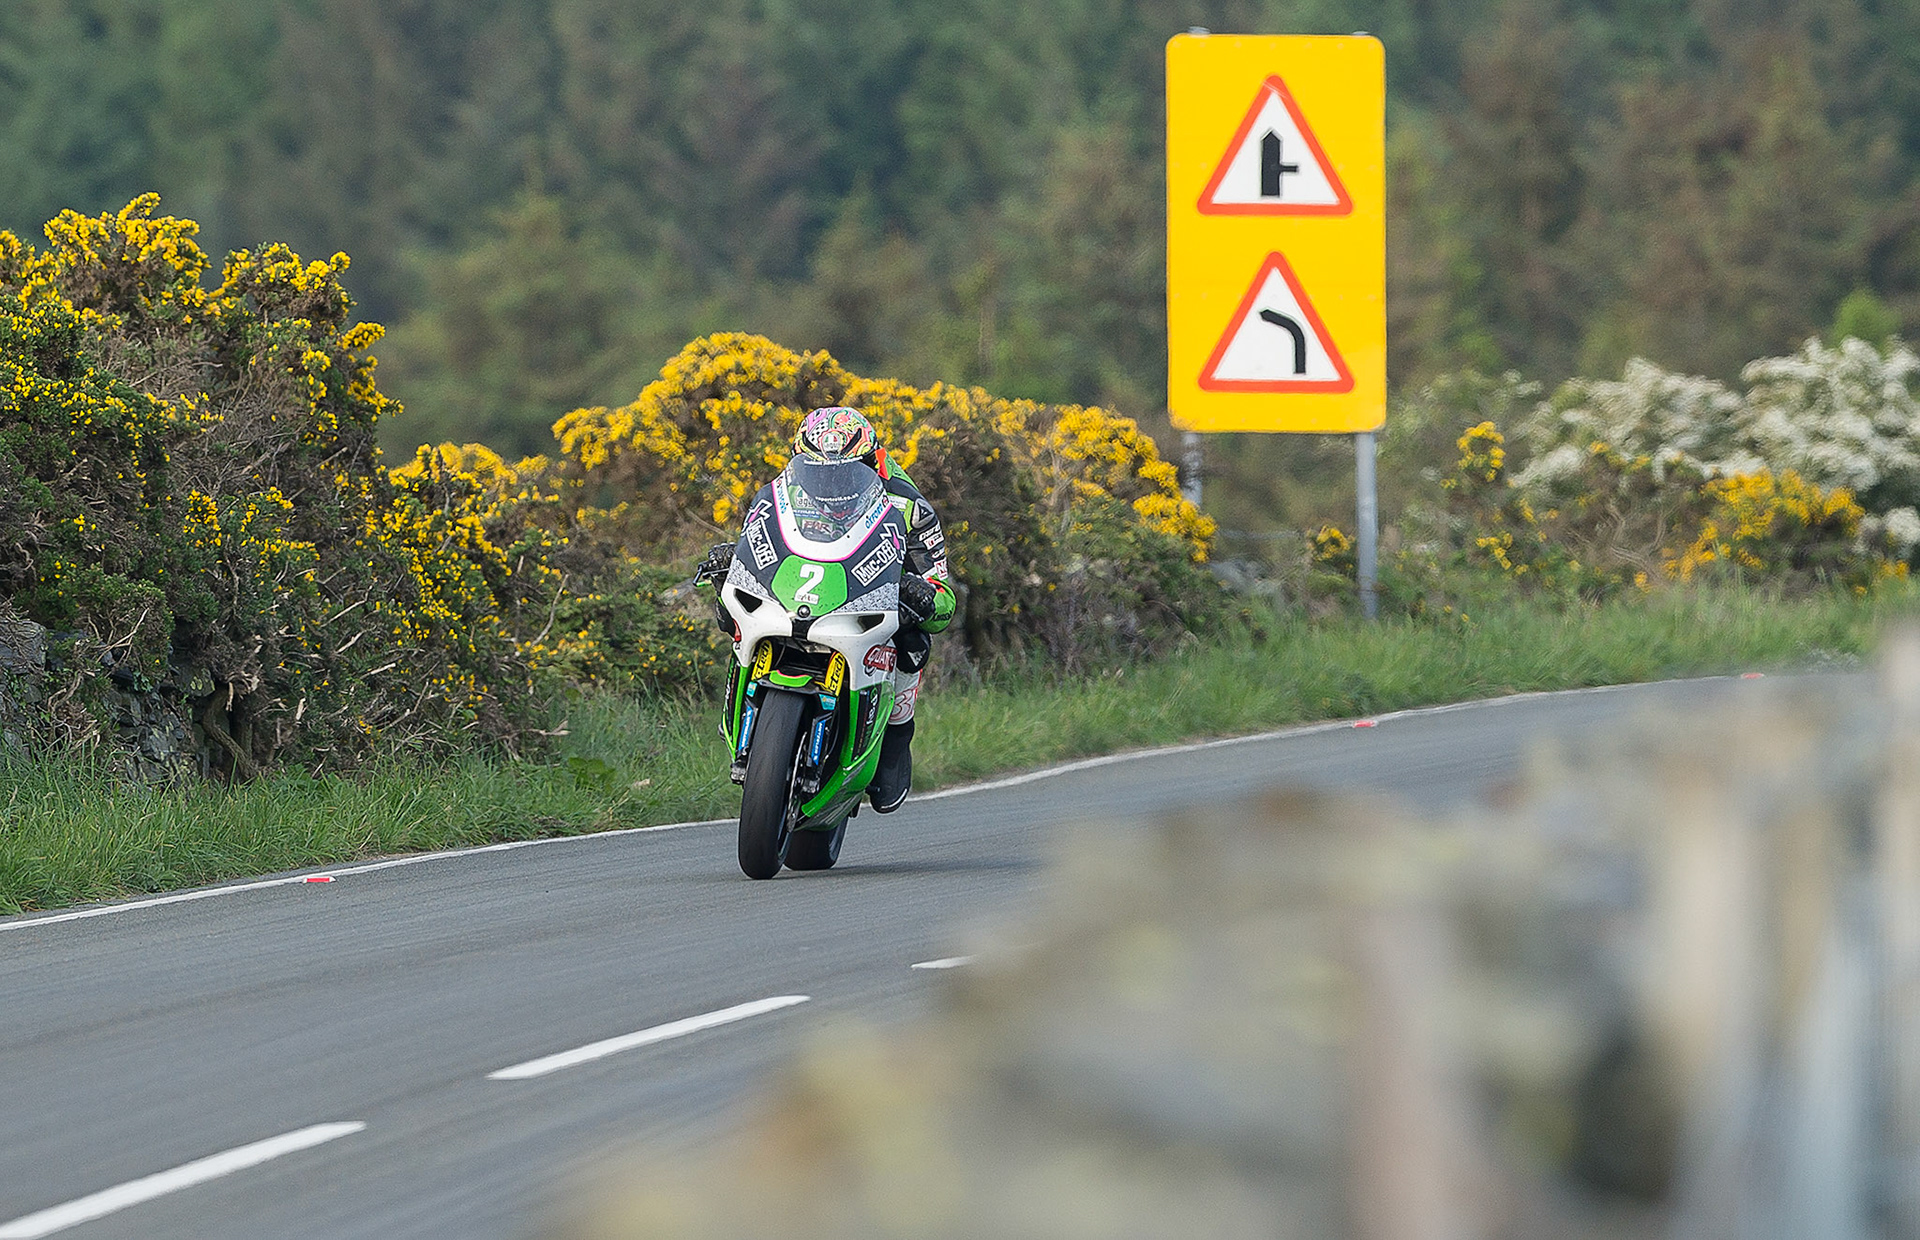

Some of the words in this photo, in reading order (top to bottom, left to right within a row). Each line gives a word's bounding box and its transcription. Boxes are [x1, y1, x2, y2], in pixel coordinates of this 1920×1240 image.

[750, 519, 775, 566] Muc-Off
[856, 542, 895, 582] Muc-Off
[794, 563, 825, 605] 2
